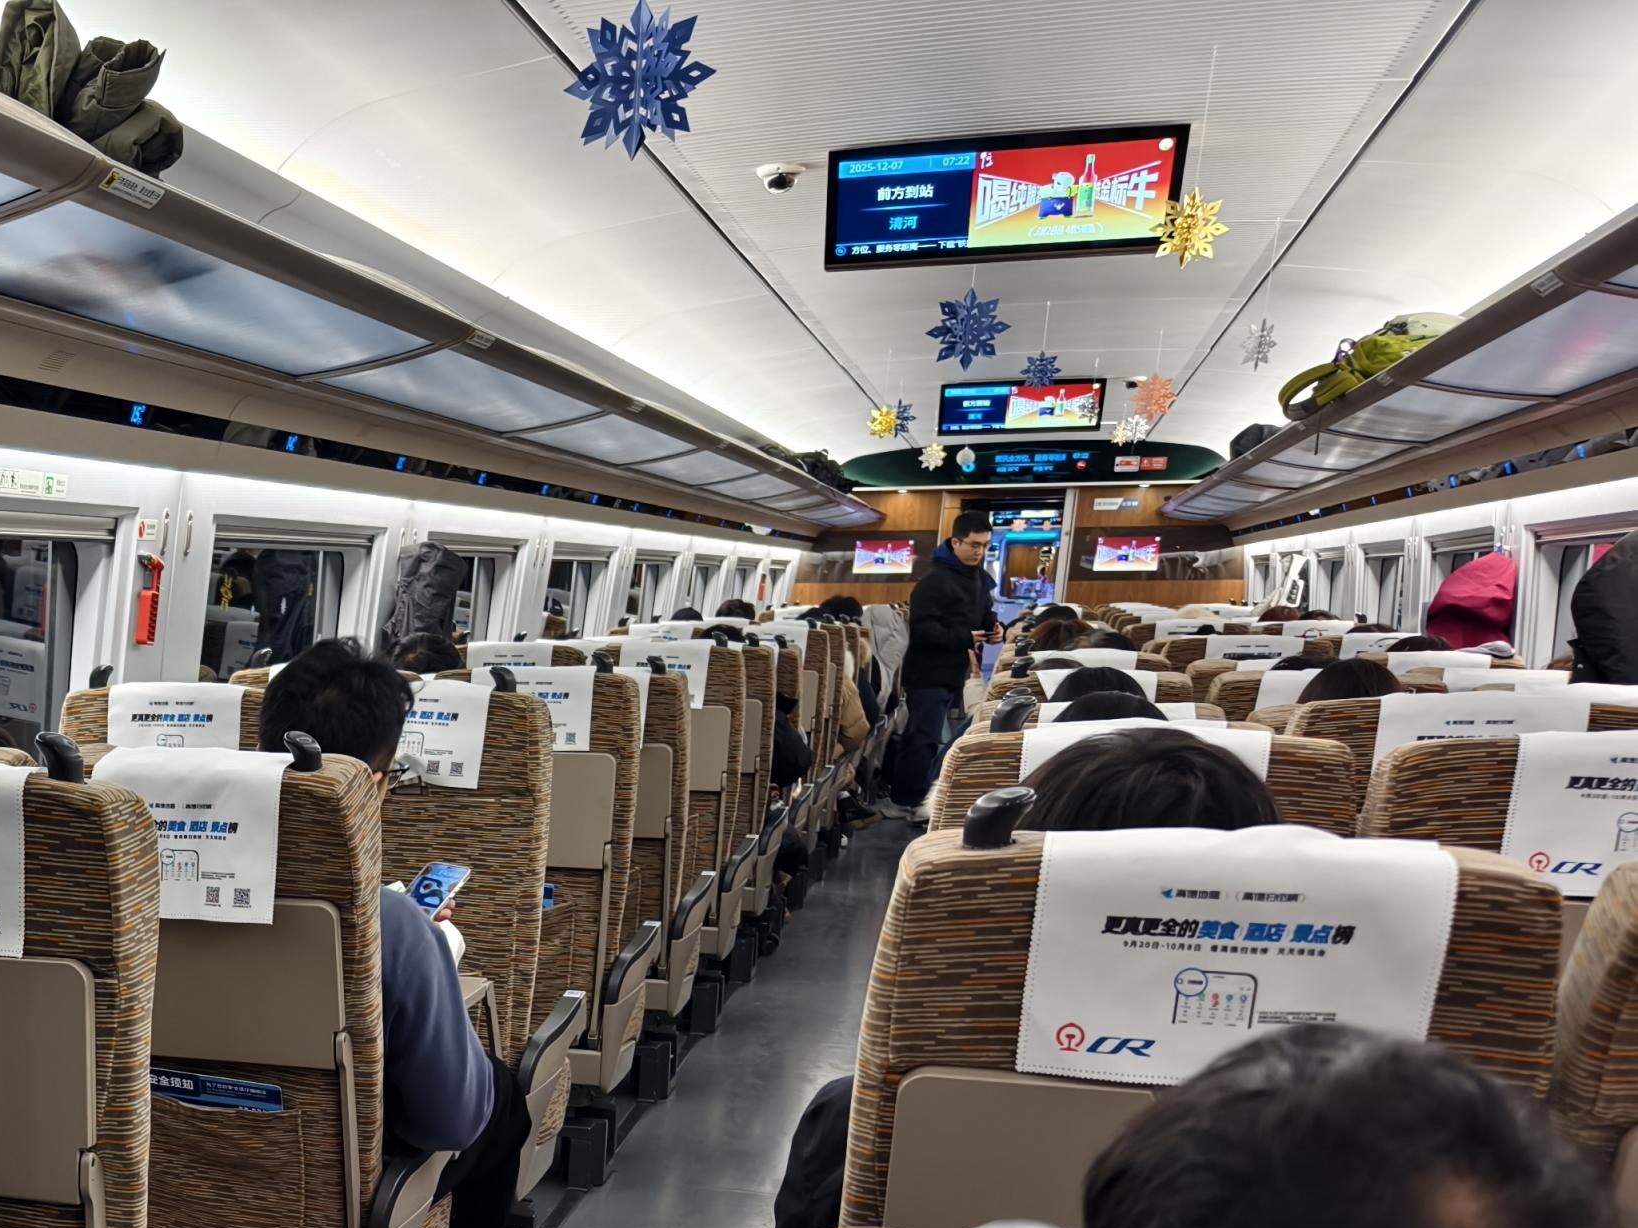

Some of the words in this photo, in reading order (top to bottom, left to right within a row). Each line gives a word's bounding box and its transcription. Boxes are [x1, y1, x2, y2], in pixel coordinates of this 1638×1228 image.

[849, 161, 904, 174] 2025-12-07
[942, 156, 971, 167] 07:22
[877, 184, 934, 201] 前方到站
[1565, 775, 1638, 792] 更真更全的
[1550, 861, 1603, 876] CR
[1243, 922, 1287, 943] 酒店
[1289, 922, 1357, 946] 景点榜
[1085, 1036, 1157, 1058] CR
